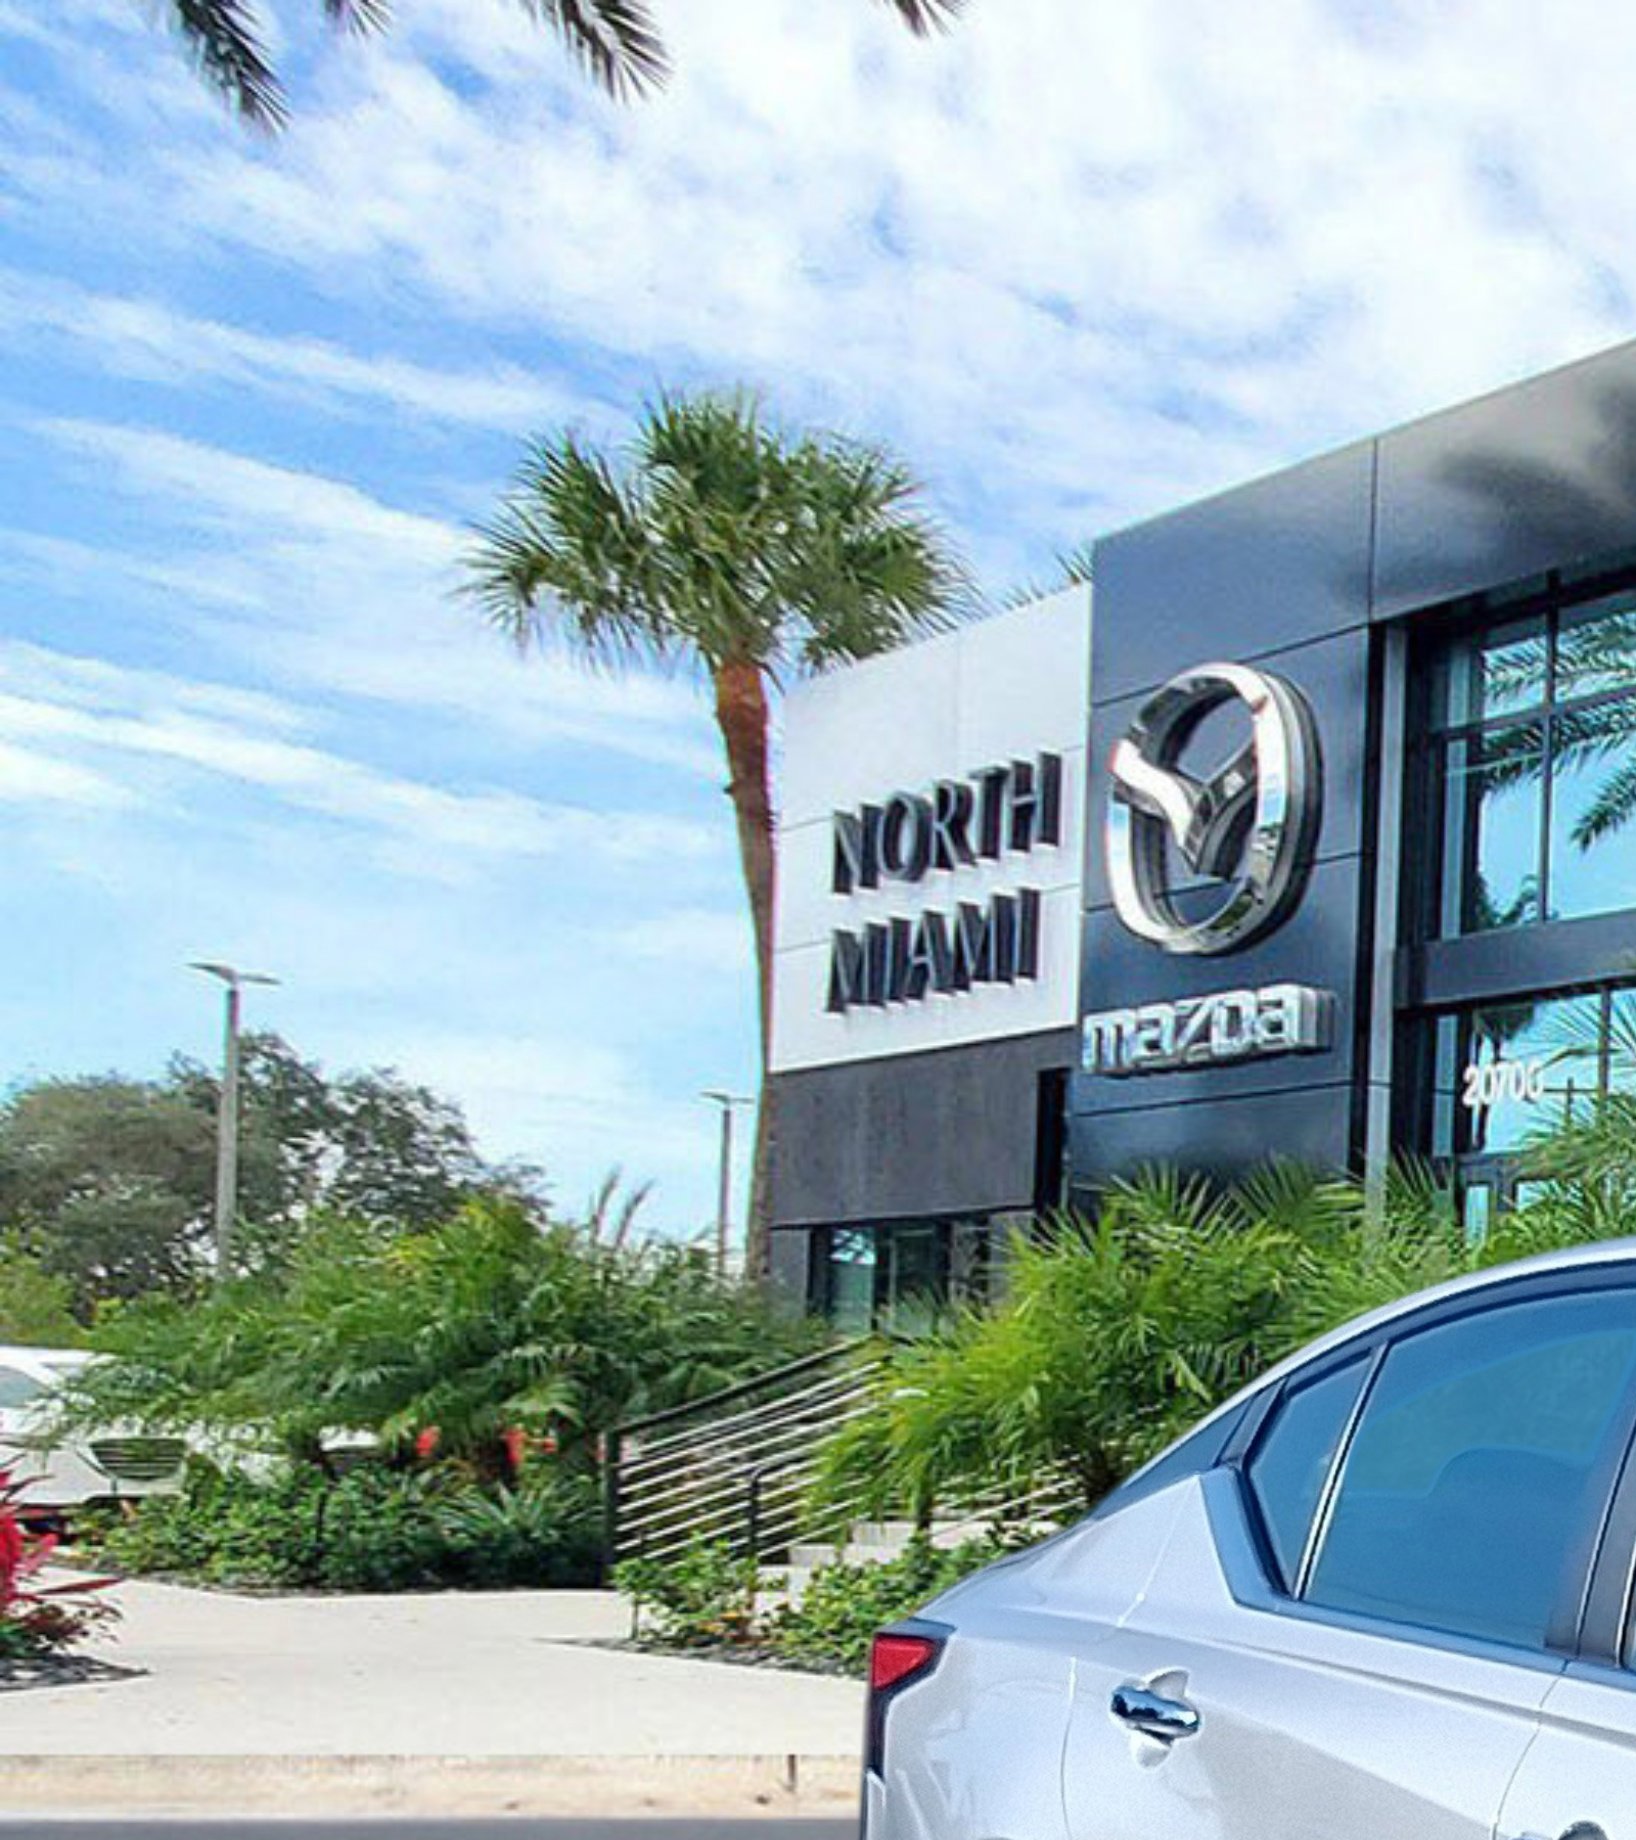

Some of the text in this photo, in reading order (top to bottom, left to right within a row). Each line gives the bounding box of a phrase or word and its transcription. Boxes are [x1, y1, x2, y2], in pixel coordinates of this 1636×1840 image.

[830, 750, 1062, 894] NORTH
[826, 887, 1042, 1013] MIAMI
[1082, 983, 1316, 1072] mazda
